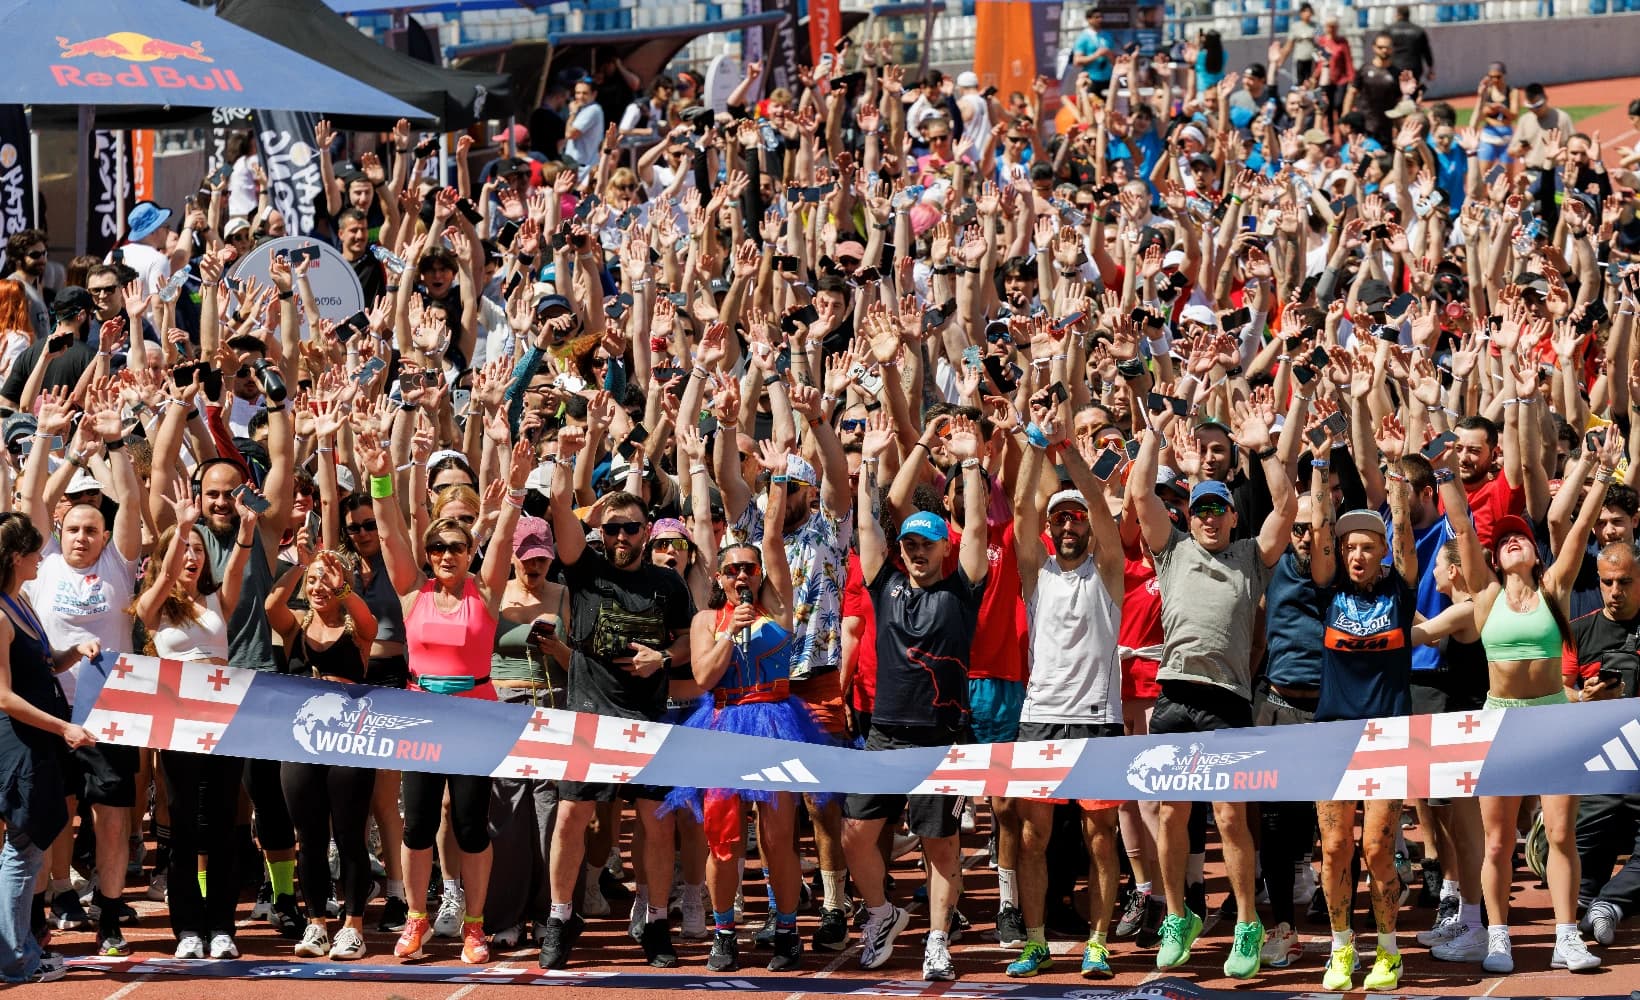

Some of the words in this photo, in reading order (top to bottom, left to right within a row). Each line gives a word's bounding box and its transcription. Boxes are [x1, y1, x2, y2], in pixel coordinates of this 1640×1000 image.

[49, 64, 148, 87] Red
[150, 66, 243, 92] Bull
[906, 519, 931, 529] HOKA
[344, 710, 398, 728] WINGS
[347, 722, 377, 737] LIFE
[316, 730, 394, 757] WORLD
[395, 739, 443, 762] RUN
[1176, 755, 1232, 766] WINGS
[1181, 764, 1212, 775] LIFE
[1151, 772, 1230, 791] WORLD
[1233, 769, 1279, 791] RUN
